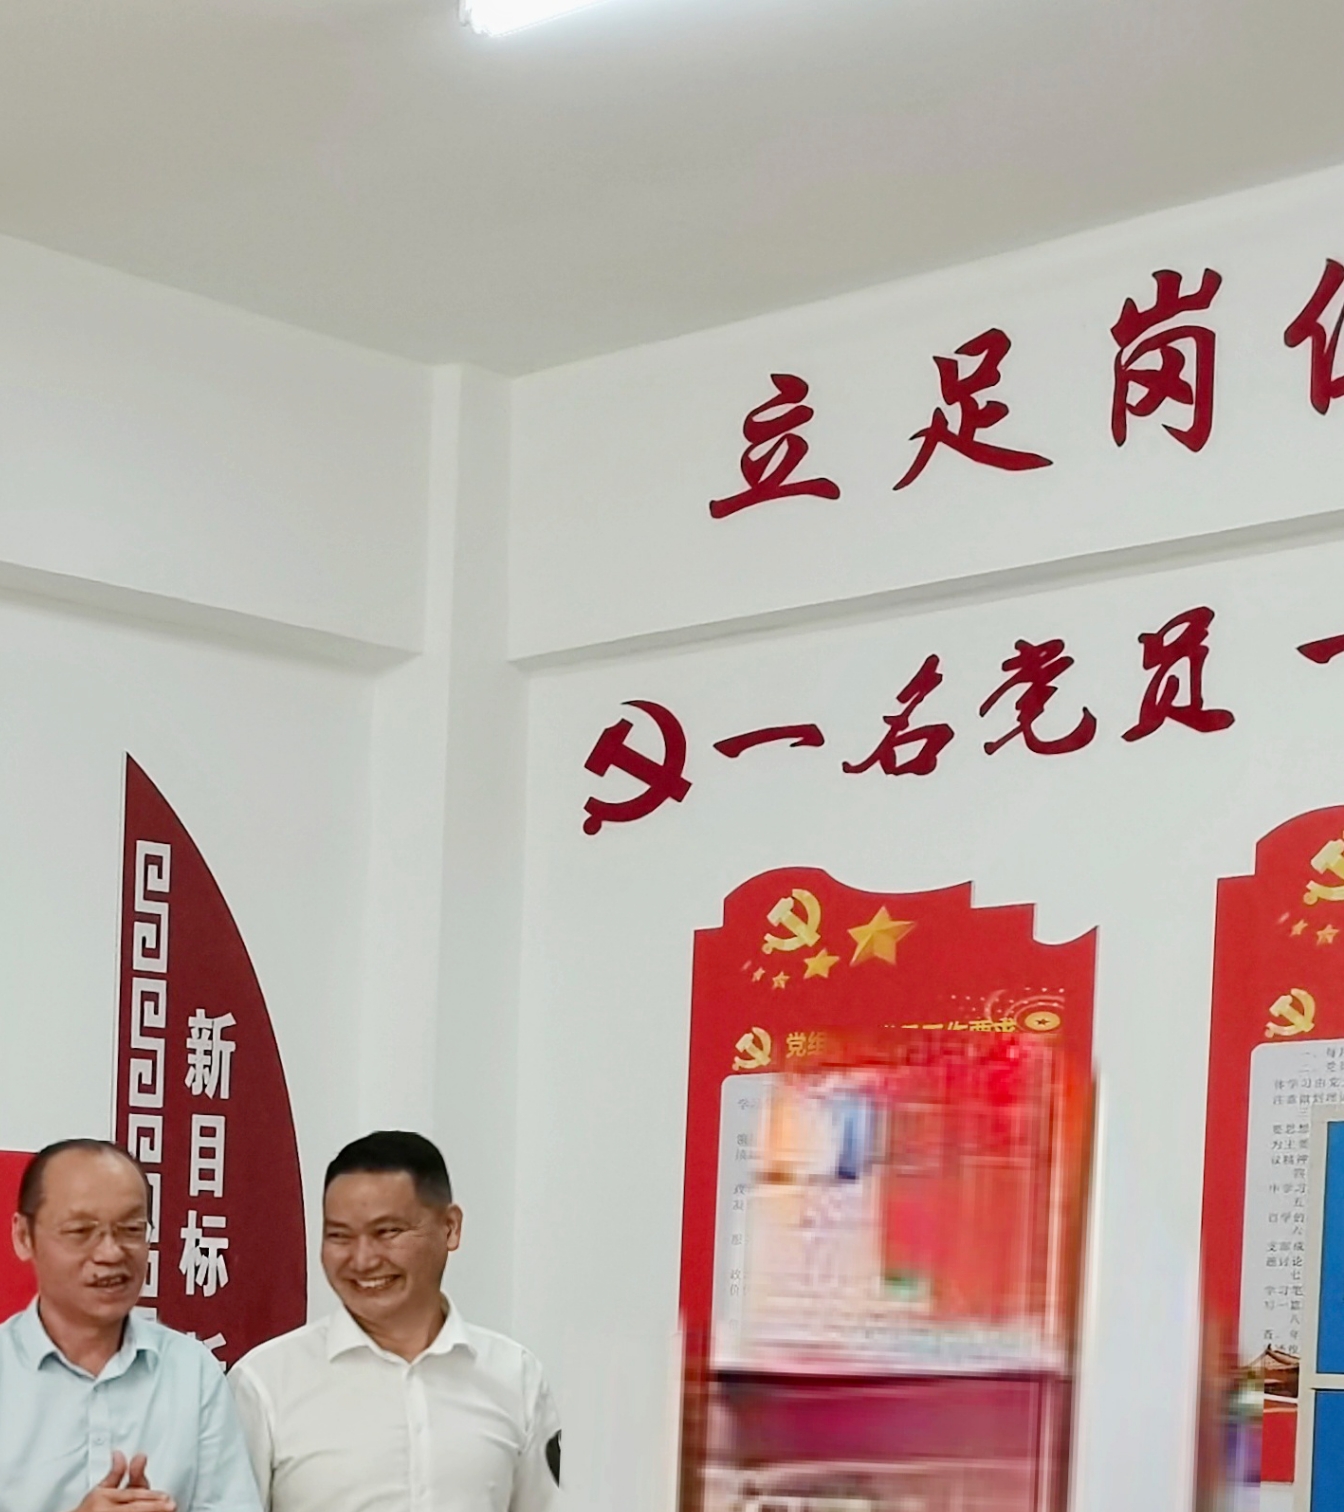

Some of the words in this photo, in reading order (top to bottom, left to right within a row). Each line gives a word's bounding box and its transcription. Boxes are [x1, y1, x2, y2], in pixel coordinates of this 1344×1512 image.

[713, 606, 1236, 777] 一名党员
[178, 1007, 238, 1298] 新目标
